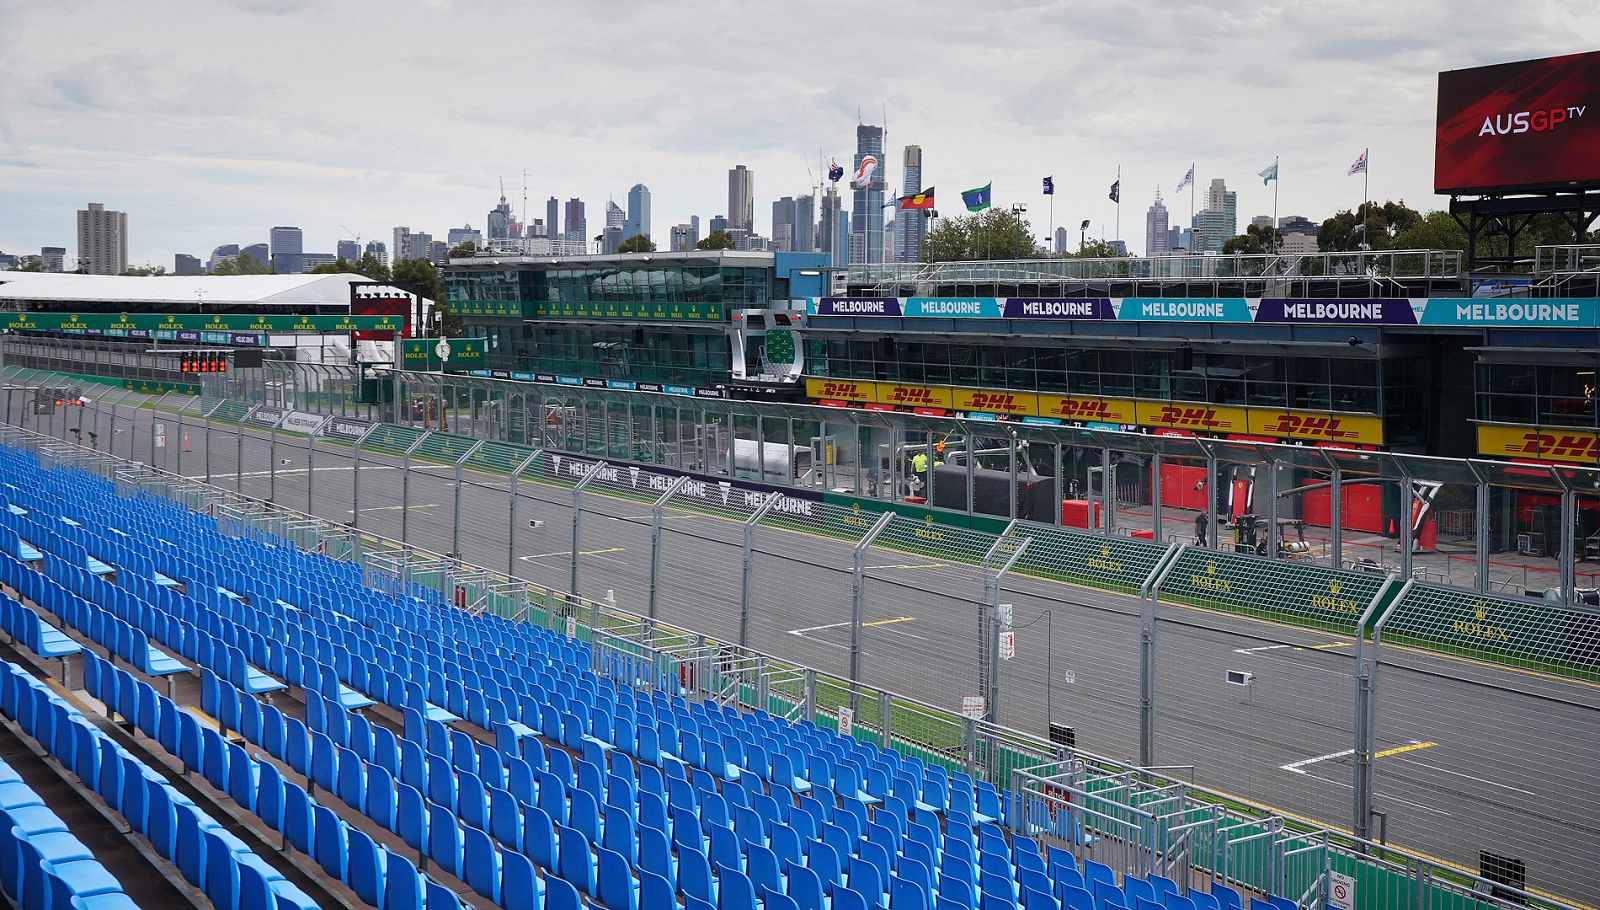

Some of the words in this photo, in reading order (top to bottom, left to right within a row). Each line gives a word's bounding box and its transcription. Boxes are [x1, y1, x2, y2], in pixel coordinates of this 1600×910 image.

[832, 300, 885, 313] MELBOURNE
[920, 301, 981, 314] MELBOURNE
[1023, 302, 1093, 316] MELBOURNE
[1141, 302, 1224, 317] MELBOURNE
[1284, 303, 1383, 319] MELBOURNE
[1456, 304, 1580, 321] MELBOURNE
[823, 383, 860, 399] DHL
[893, 387, 934, 404] DHL
[972, 393, 1018, 410] DHL
[1060, 399, 1112, 418] DHL
[1160, 407, 1220, 427] DHL
[1276, 415, 1345, 438] DHL
[569, 462, 618, 482] MELBURNE
[649, 475, 706, 497] MELBURNE
[1088, 558, 1123, 573] ROLEX
[1191, 575, 1232, 593] ROLEX
[1311, 595, 1359, 614] ROLEX
[1452, 620, 1509, 642] ROLEX
